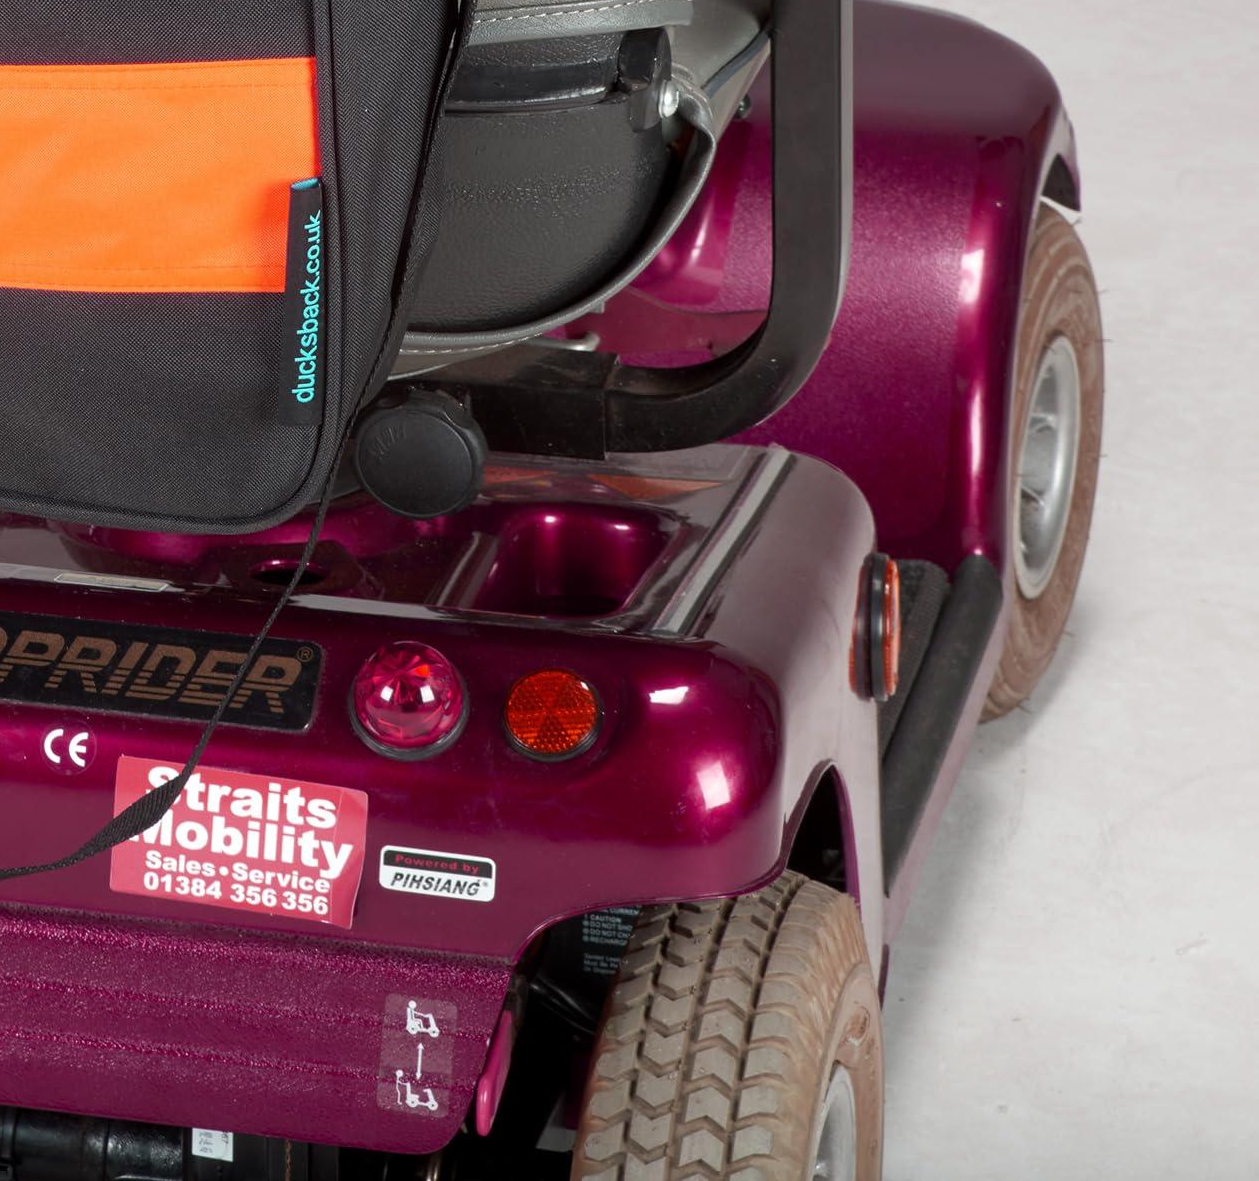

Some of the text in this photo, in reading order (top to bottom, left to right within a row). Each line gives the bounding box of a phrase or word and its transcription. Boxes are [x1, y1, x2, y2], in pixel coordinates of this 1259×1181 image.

[292, 209, 321, 403] ducksback.co.uk
[44, 728, 89, 768] CE
[128, 809, 354, 880] Mobility
[394, 854, 479, 874] Powered by
[143, 871, 329, 915] 01384 356 356
[145, 850, 330, 893] Sales Service
[390, 872, 480, 896] PIHSIANG
